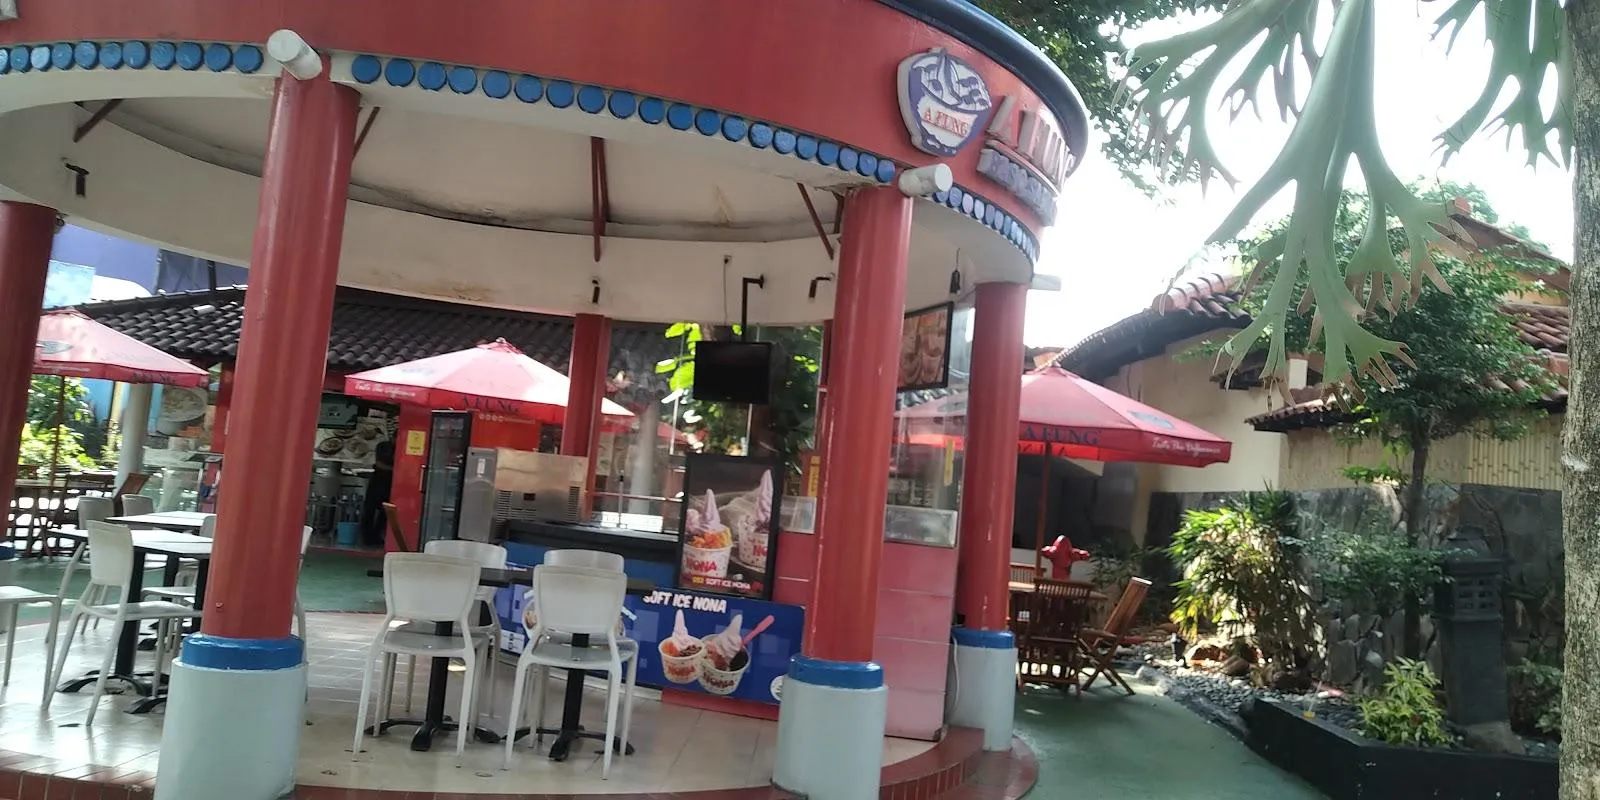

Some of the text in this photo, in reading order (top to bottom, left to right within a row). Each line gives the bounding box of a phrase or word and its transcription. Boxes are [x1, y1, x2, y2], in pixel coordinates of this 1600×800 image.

[923, 107, 969, 137] A FUNG
[984, 94, 1018, 148] A
[1022, 424, 1101, 446] A FUNG
[672, 593, 692, 608] ICE
[692, 596, 727, 614] NONA
